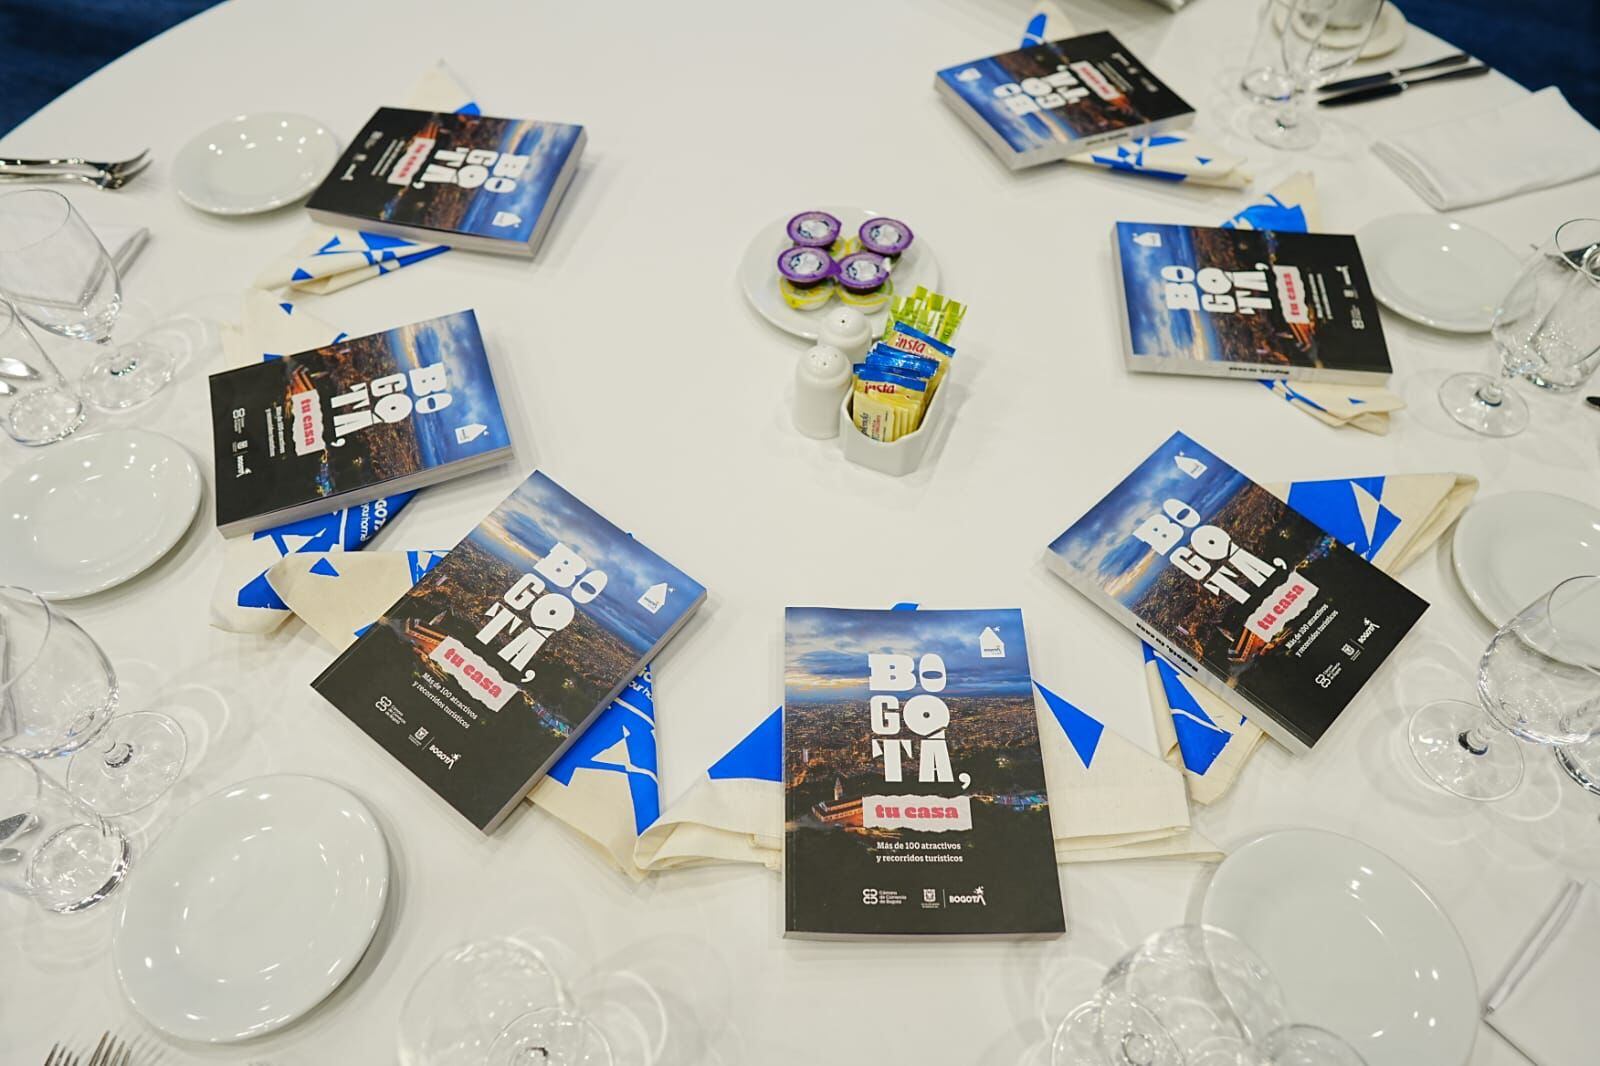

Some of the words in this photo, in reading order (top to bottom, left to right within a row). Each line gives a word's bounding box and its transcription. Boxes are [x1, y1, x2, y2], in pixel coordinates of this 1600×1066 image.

[993, 83, 1041, 115] BO
[1021, 77, 1066, 109] GO
[458, 149, 499, 189] GO
[484, 153, 530, 193] BO
[1161, 265, 1200, 311] BO
[1197, 267, 1236, 313] GO
[895, 334, 927, 353] insta
[301, 398, 311, 414] tu
[370, 373, 413, 423] GO
[409, 362, 453, 414] BO
[303, 415, 315, 446] casa
[1132, 498, 1201, 556] BO
[532, 542, 608, 604] BO
[1170, 525, 1232, 580] GO
[504, 573, 575, 631] GO
[1257, 614, 1277, 630] tu
[1272, 584, 1304, 614] casa
[444, 648, 464, 668] tu
[463, 664, 502, 698] casa
[868, 653, 947, 692] BO
[416, 684, 444, 708] recorridos
[444, 704, 470, 728] turísticos
[422, 672, 435, 684] Más
[433, 682, 442, 690] de
[440, 687, 452, 698] 100
[450, 695, 478, 720] atractivos
[870, 694, 950, 736] GO
[875, 804, 900, 818] tu
[904, 806, 959, 818] casa
[876, 841, 893, 850] Más
[894, 842, 904, 850] de
[905, 841, 920, 850] 100
[921, 842, 962, 850] atractivos
[876, 855, 882, 863] y
[882, 854, 924, 862] recorridos
[925, 854, 964, 862] turísticos
